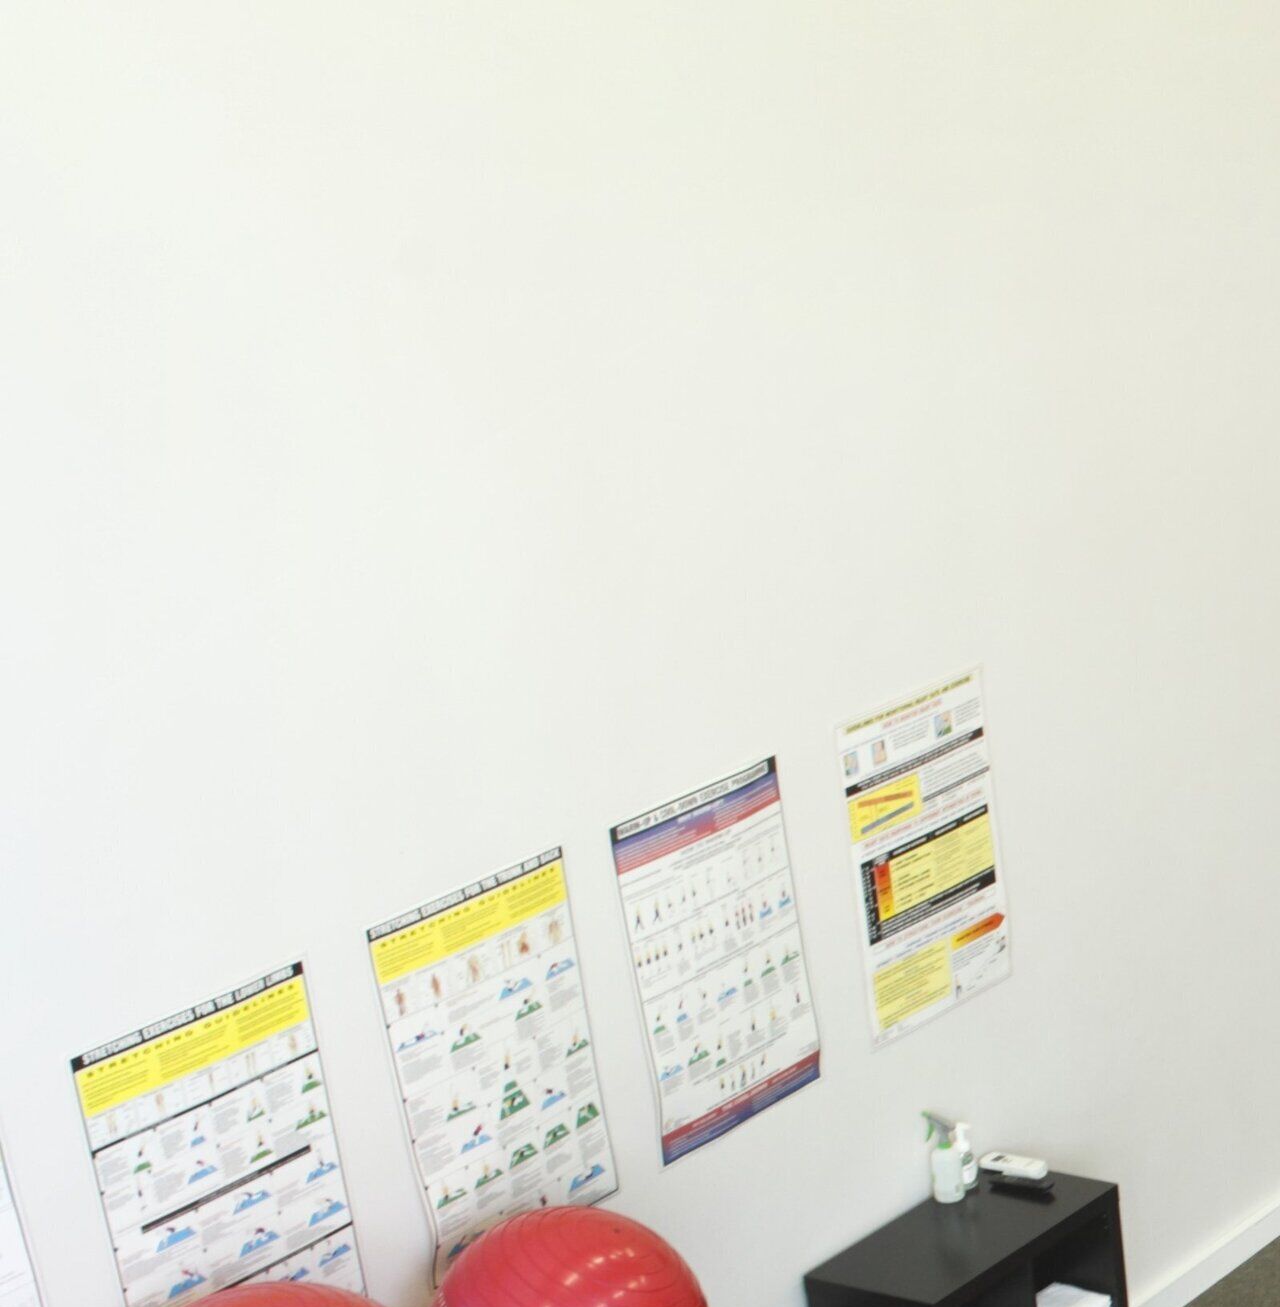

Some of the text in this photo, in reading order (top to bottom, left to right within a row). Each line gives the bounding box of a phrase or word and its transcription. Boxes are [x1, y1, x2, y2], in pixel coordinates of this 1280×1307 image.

[81, 1030, 143, 1066] STRETCHING
[143, 1007, 195, 1040] EXERCISES
[194, 999, 217, 1018] FOR
[86, 1030, 194, 1079] STRETCHING
[203, 984, 294, 1029] GUIDELINES
